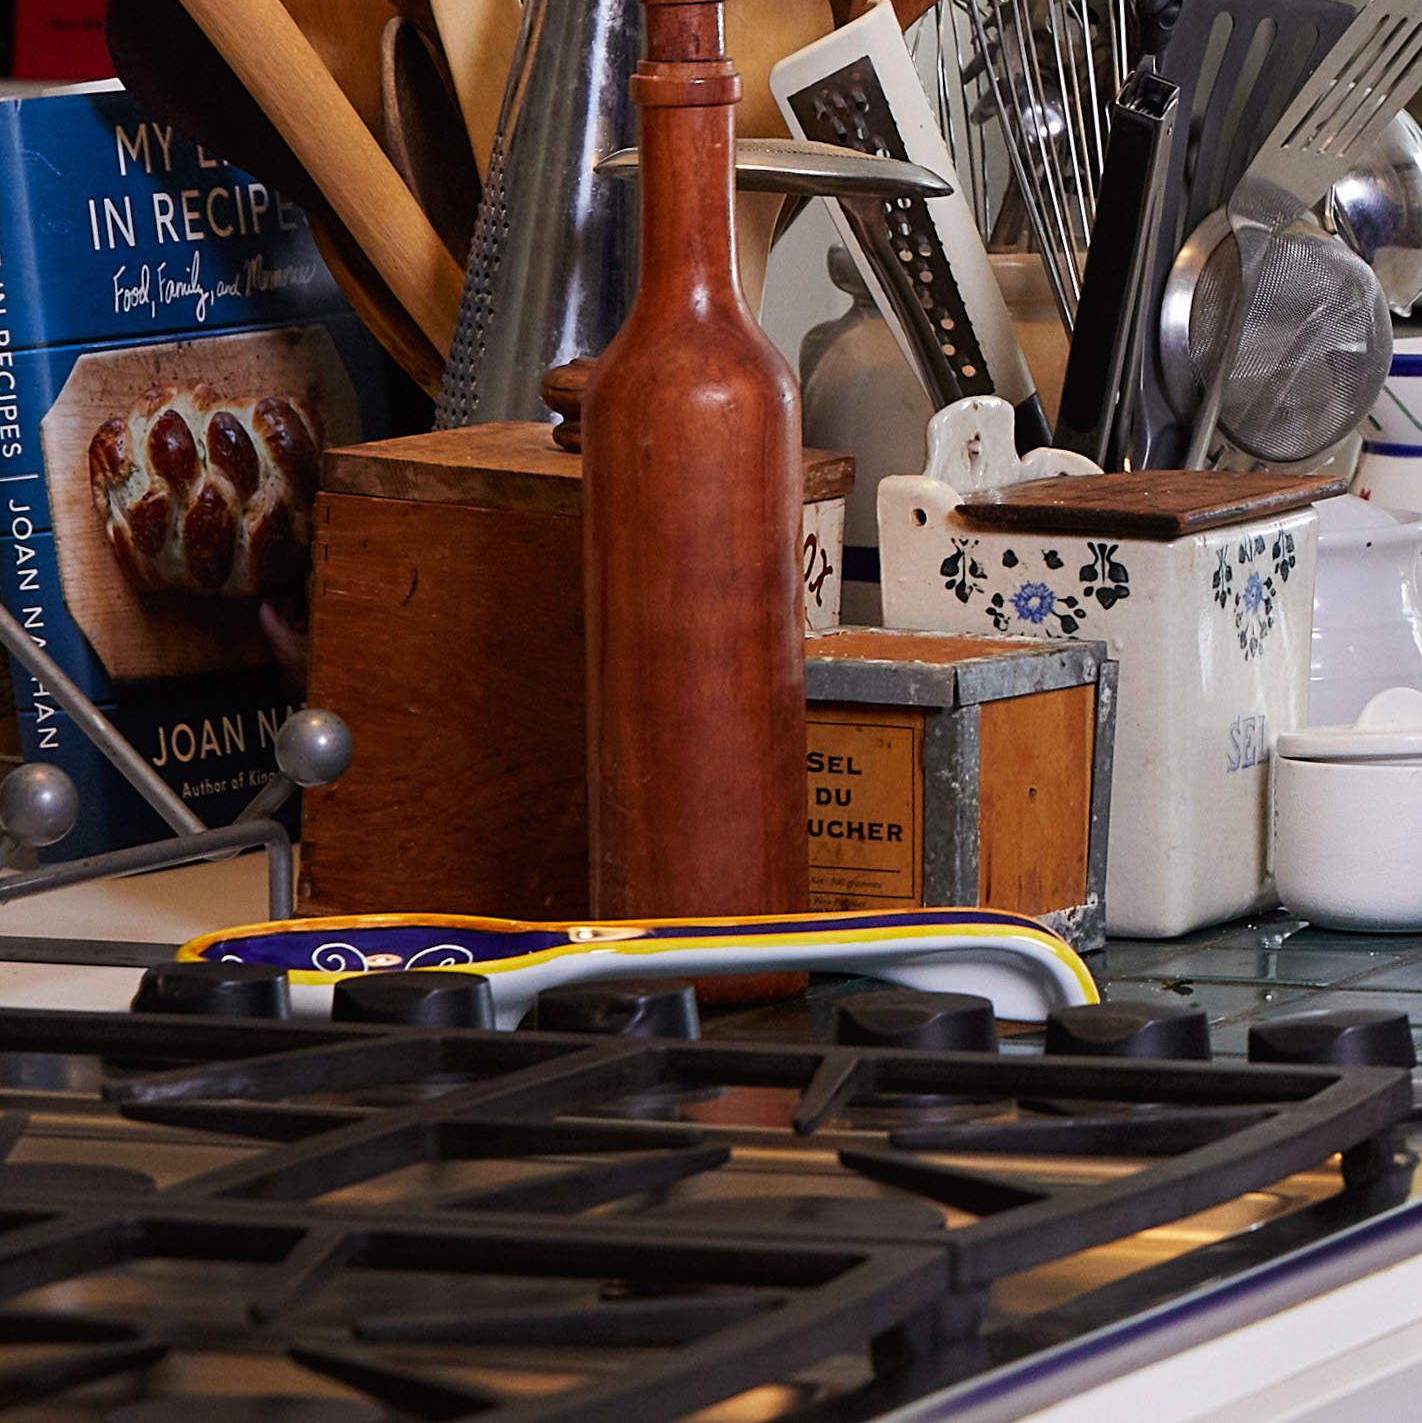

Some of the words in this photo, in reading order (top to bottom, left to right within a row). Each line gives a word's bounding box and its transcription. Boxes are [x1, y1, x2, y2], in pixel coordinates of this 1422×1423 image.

[115, 123, 172, 176] MY
[88, 195, 136, 251] IN
[152, 182, 310, 244] RECIPE
[113, 264, 156, 318] Food,
[157, 250, 215, 322] Family,
[216, 273, 241, 297] and
[9, 498, 41, 591] JOAN
[22, 606, 60, 749] NAHAN
[152, 714, 246, 767] JOAN
[807, 751, 862, 776] SEL
[1226, 714, 1269, 774] SEL
[182, 781, 227, 799] Author
[231, 771, 244, 791] of
[815, 787, 853, 807] DU
[808, 819, 903, 843] UCHER
